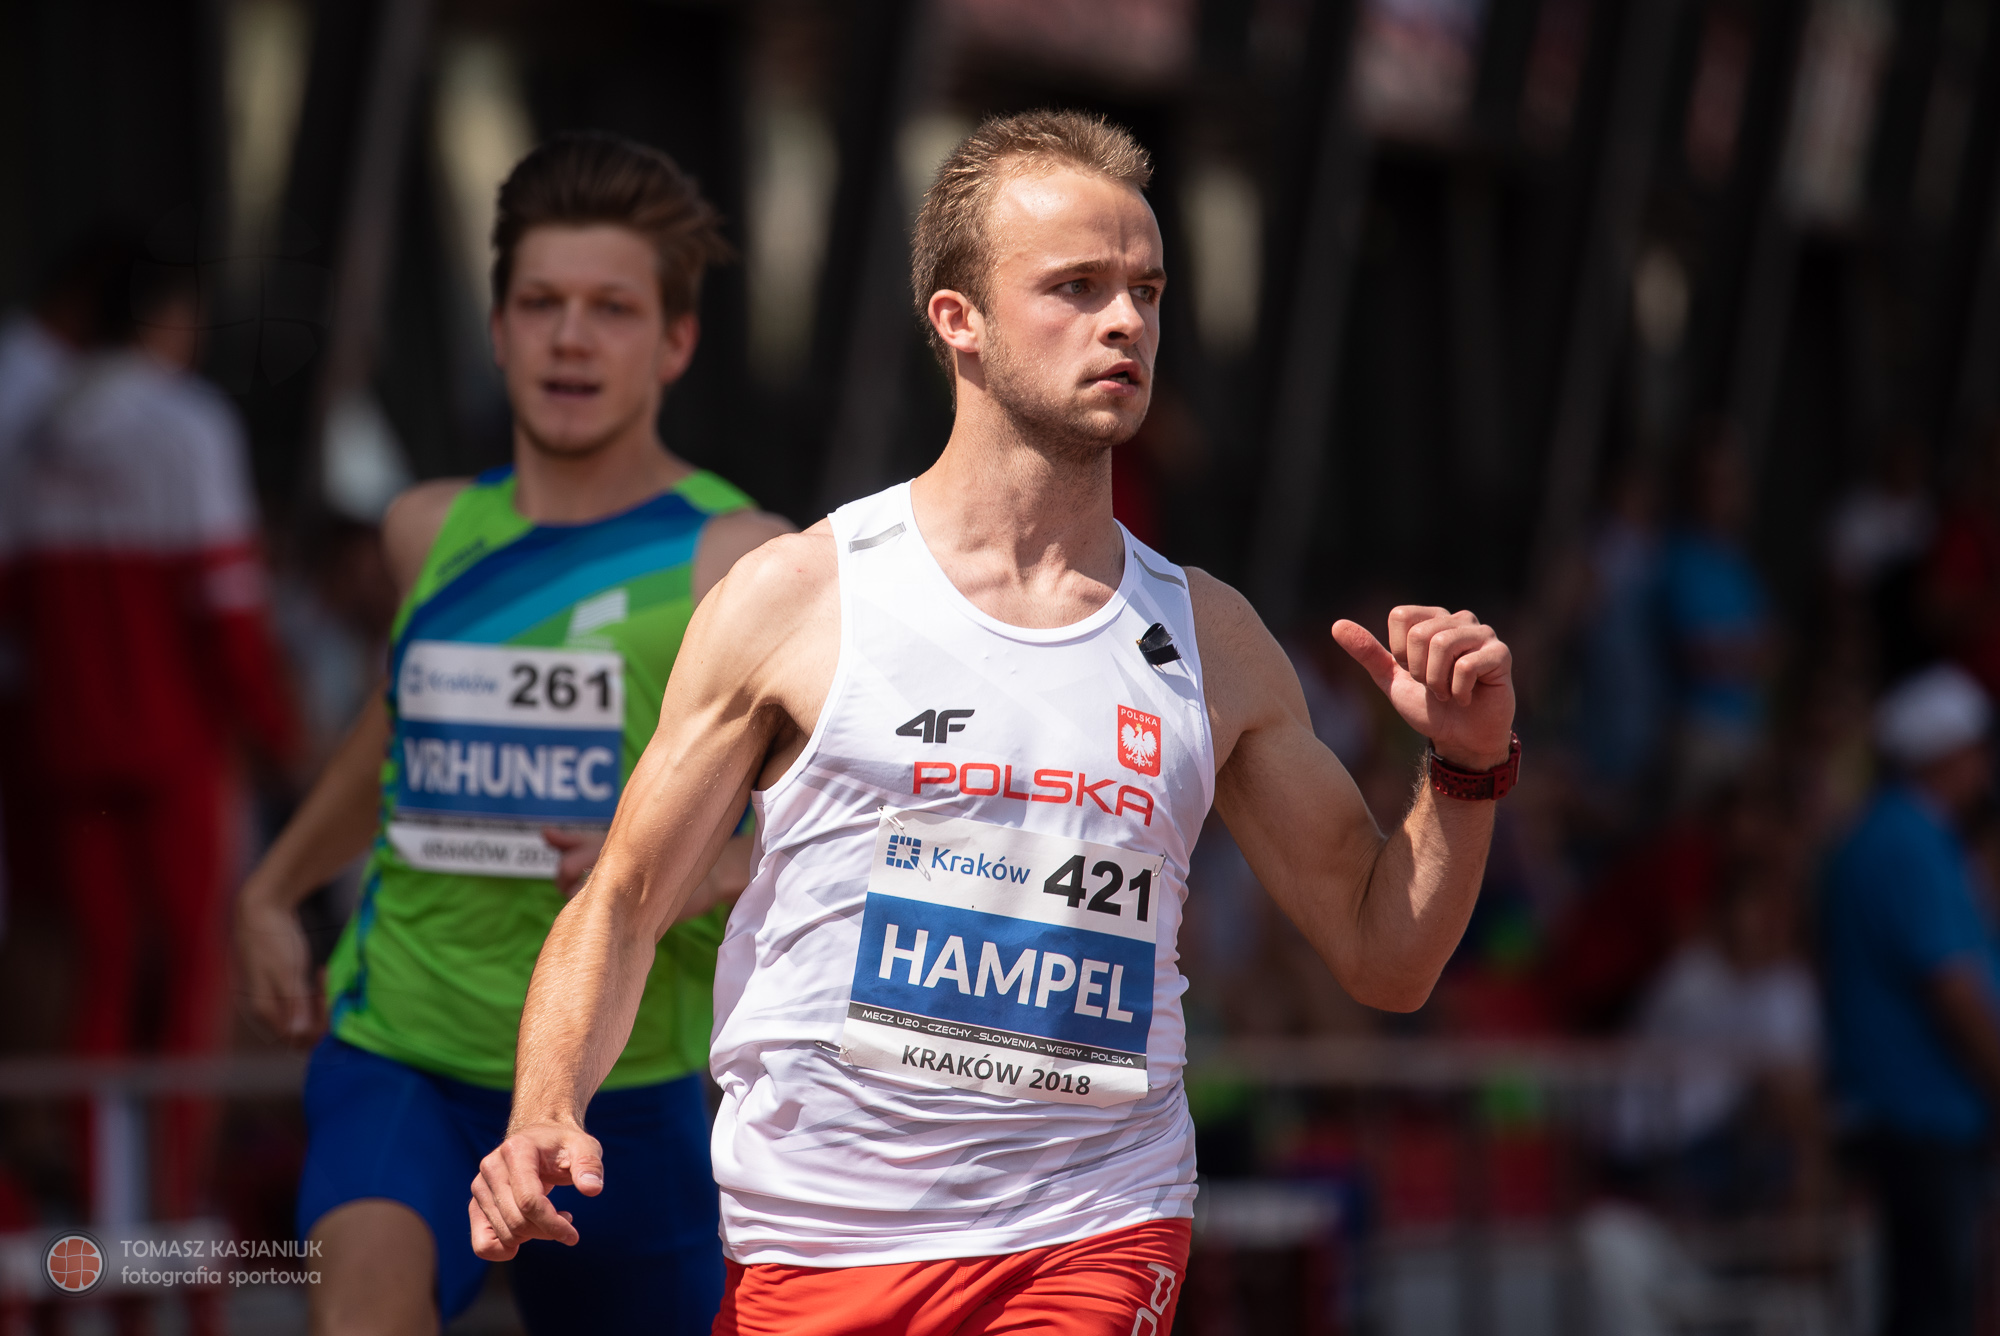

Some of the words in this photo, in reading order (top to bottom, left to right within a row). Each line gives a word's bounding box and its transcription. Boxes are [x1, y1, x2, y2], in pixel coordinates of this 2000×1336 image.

[508, 663, 613, 711] 261
[895, 709, 975, 743] 4F
[1121, 708, 1158, 727] POLSKA
[403, 736, 615, 802] VRHUNEC
[913, 761, 1155, 827] POLSKA
[931, 846, 1031, 885] Kraków
[1043, 854, 1153, 922] 421
[878, 923, 1134, 1023] HAMPEL
[862, 1009, 895, 1023] MECZ
[896, 1016, 920, 1029] U20
[1090, 1051, 1134, 1066] POLSKA
[901, 1044, 1024, 1085] KRAKÓW
[1028, 1068, 1092, 1096] 2018
